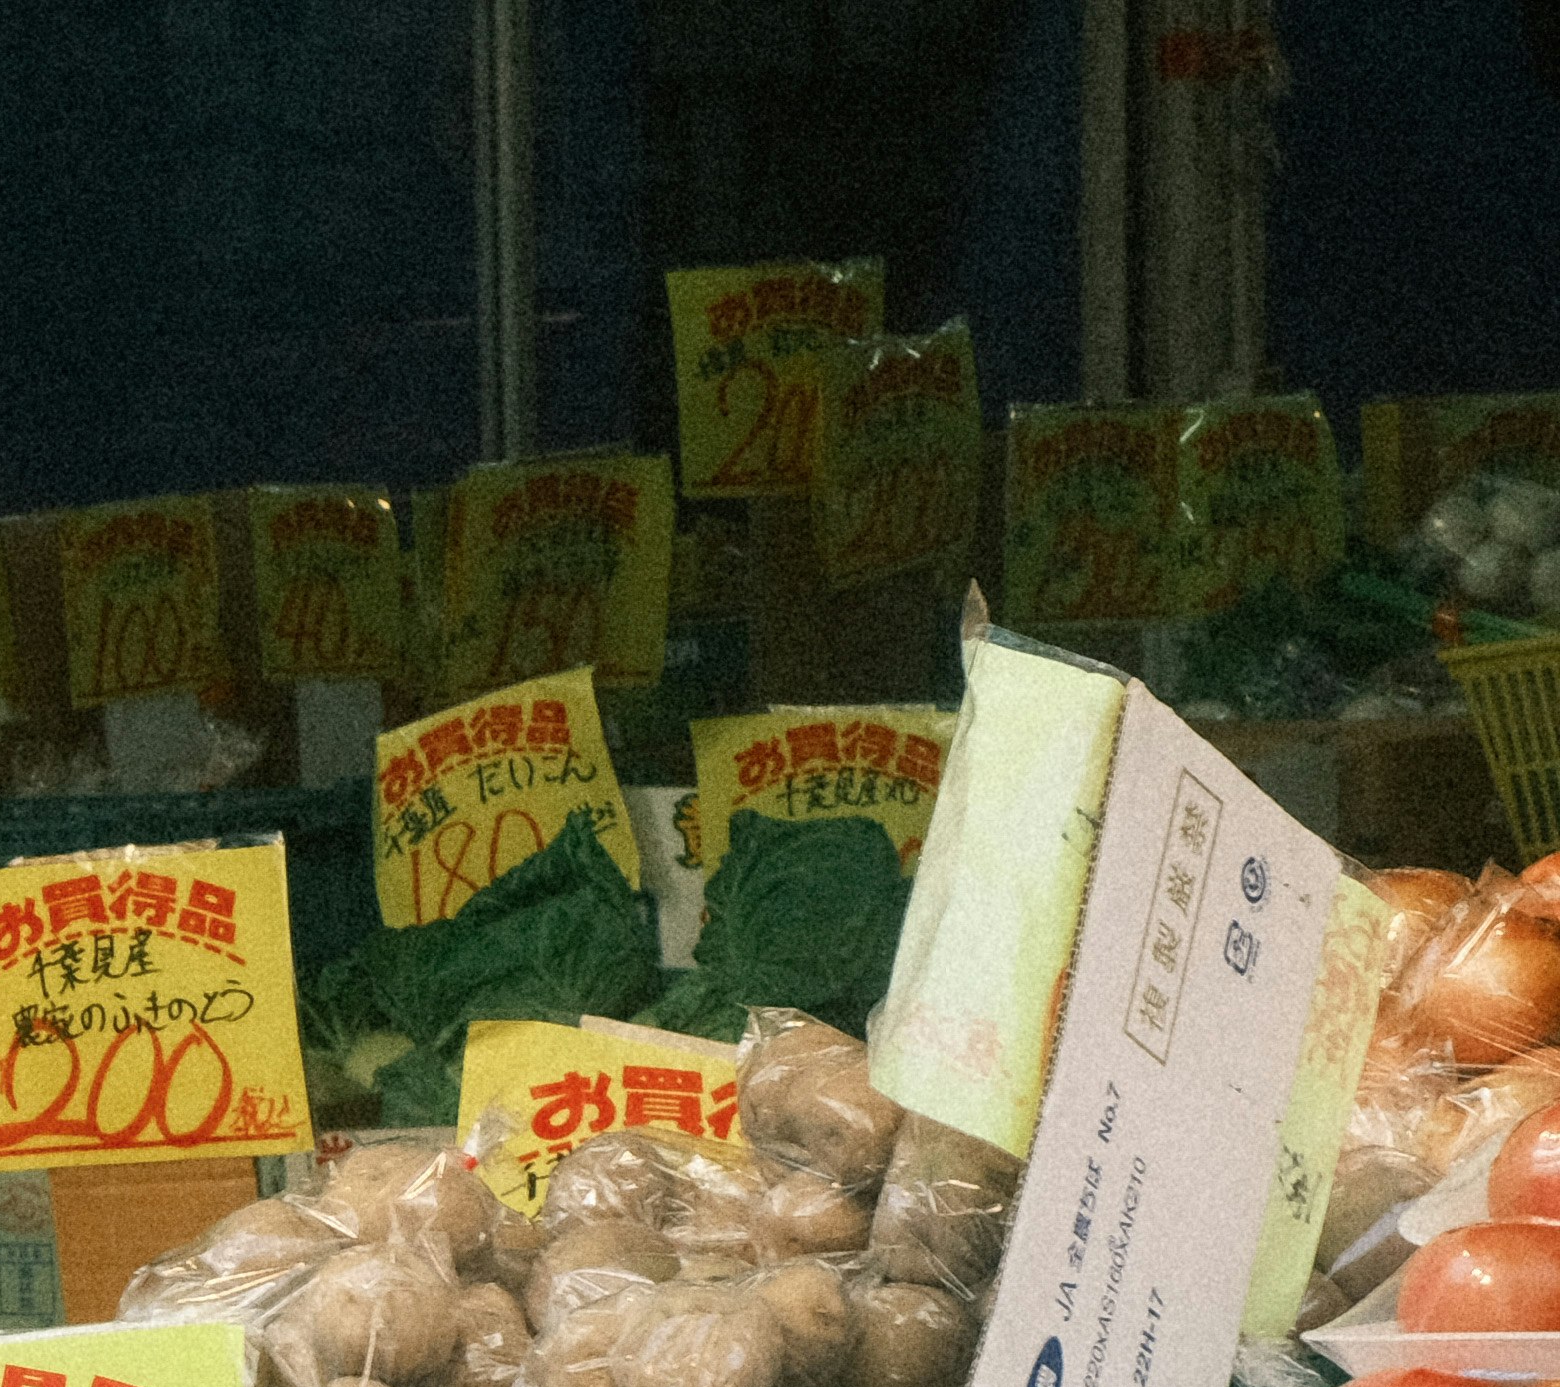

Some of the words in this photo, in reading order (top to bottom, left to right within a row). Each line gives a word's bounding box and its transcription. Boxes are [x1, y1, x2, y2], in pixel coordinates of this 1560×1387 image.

[380, 699, 571, 803] お買得品
[468, 748, 597, 804] だいこん
[732, 719, 943, 789] お買得品
[1137, 800, 1214, 1032] 複製厳禁
[1055, 1267, 1084, 1326] JA
[1094, 1080, 1126, 1143] No.7
